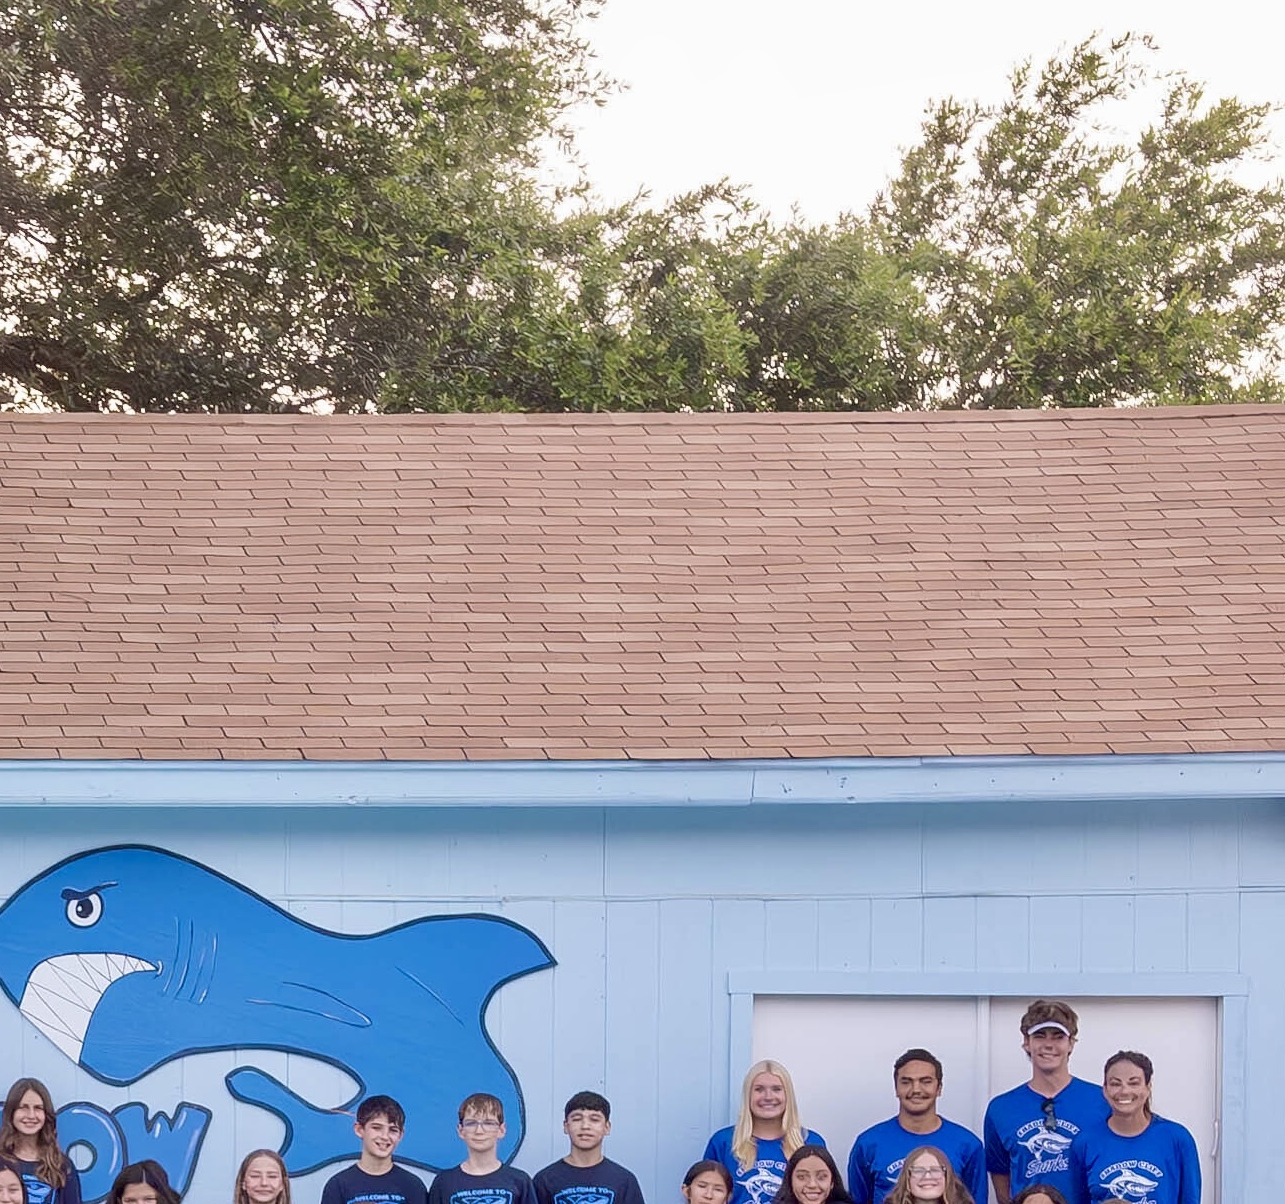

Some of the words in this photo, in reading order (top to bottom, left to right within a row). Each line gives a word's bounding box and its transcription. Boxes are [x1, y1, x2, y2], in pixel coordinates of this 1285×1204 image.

[1025, 1156, 1069, 1179] Sharks
[1100, 1160, 1137, 1180] SHADOW
[1138, 1160, 1163, 1177] CLIFF
[457, 1189, 494, 1197] WELCOME
[561, 1187, 596, 1195] WELCOME
[355, 1194, 388, 1202] WELCOME
